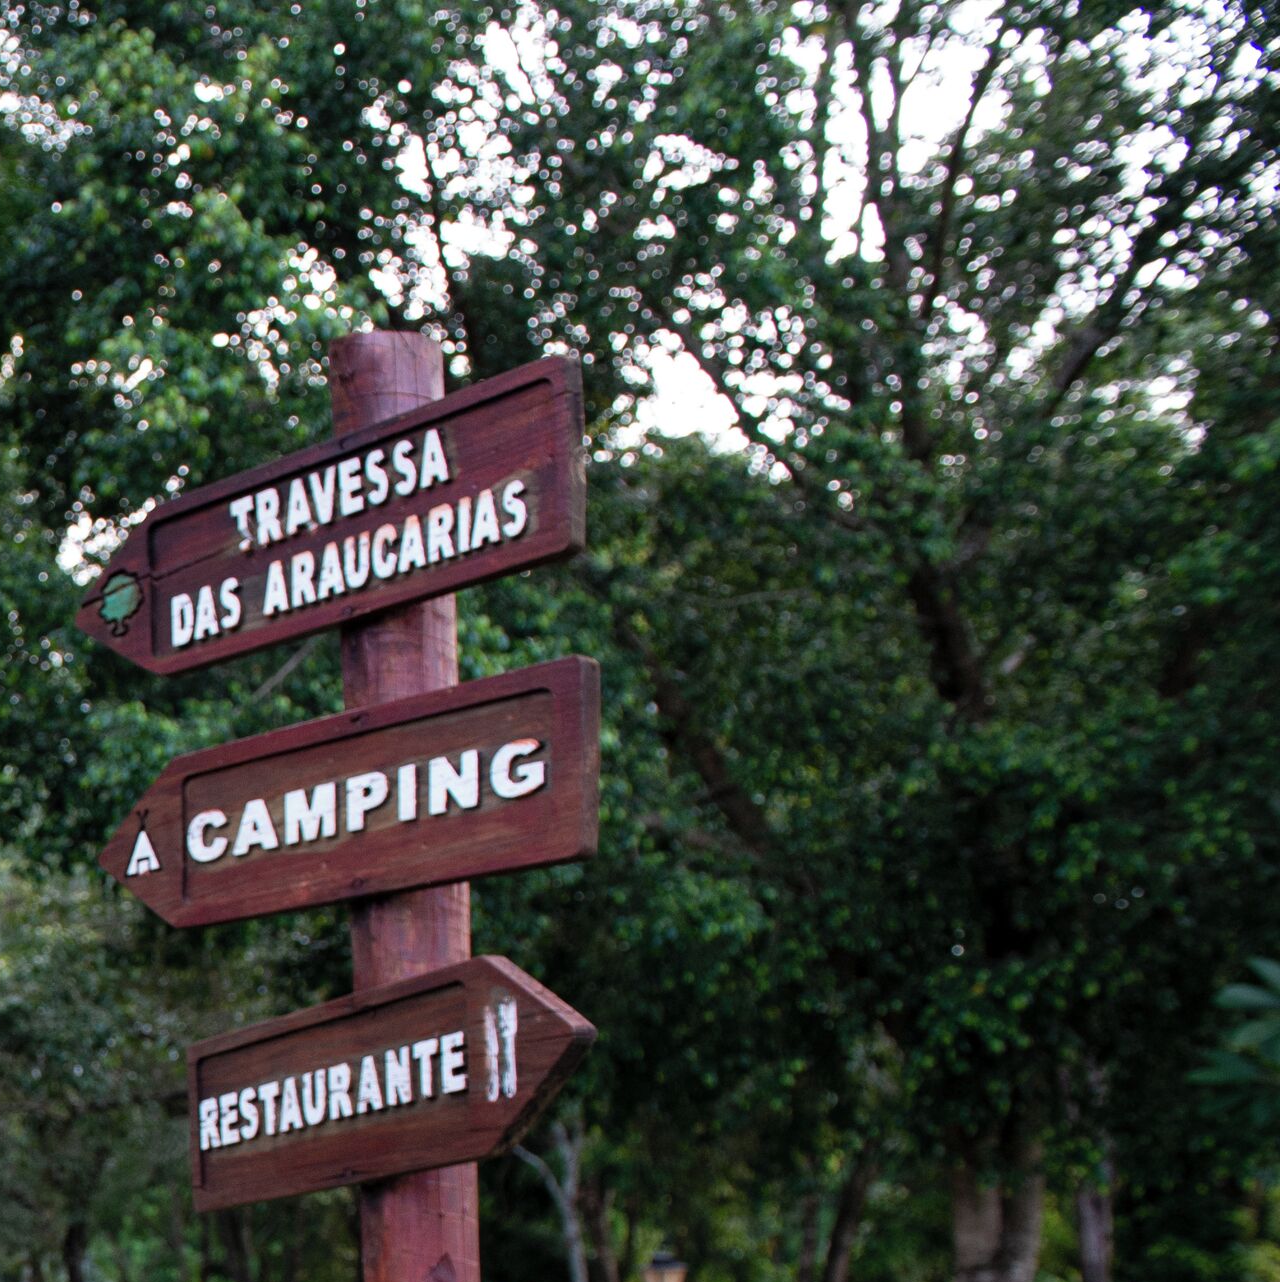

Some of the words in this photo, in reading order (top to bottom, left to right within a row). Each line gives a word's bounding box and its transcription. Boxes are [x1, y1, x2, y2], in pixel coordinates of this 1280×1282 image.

[230, 428, 450, 549] TRAVESSA
[170, 577, 241, 647] DAS
[262, 479, 527, 616] ARAUCARIAS
[186, 738, 545, 863] CAMPING
[199, 1031, 468, 1151] RESTAURANTE
